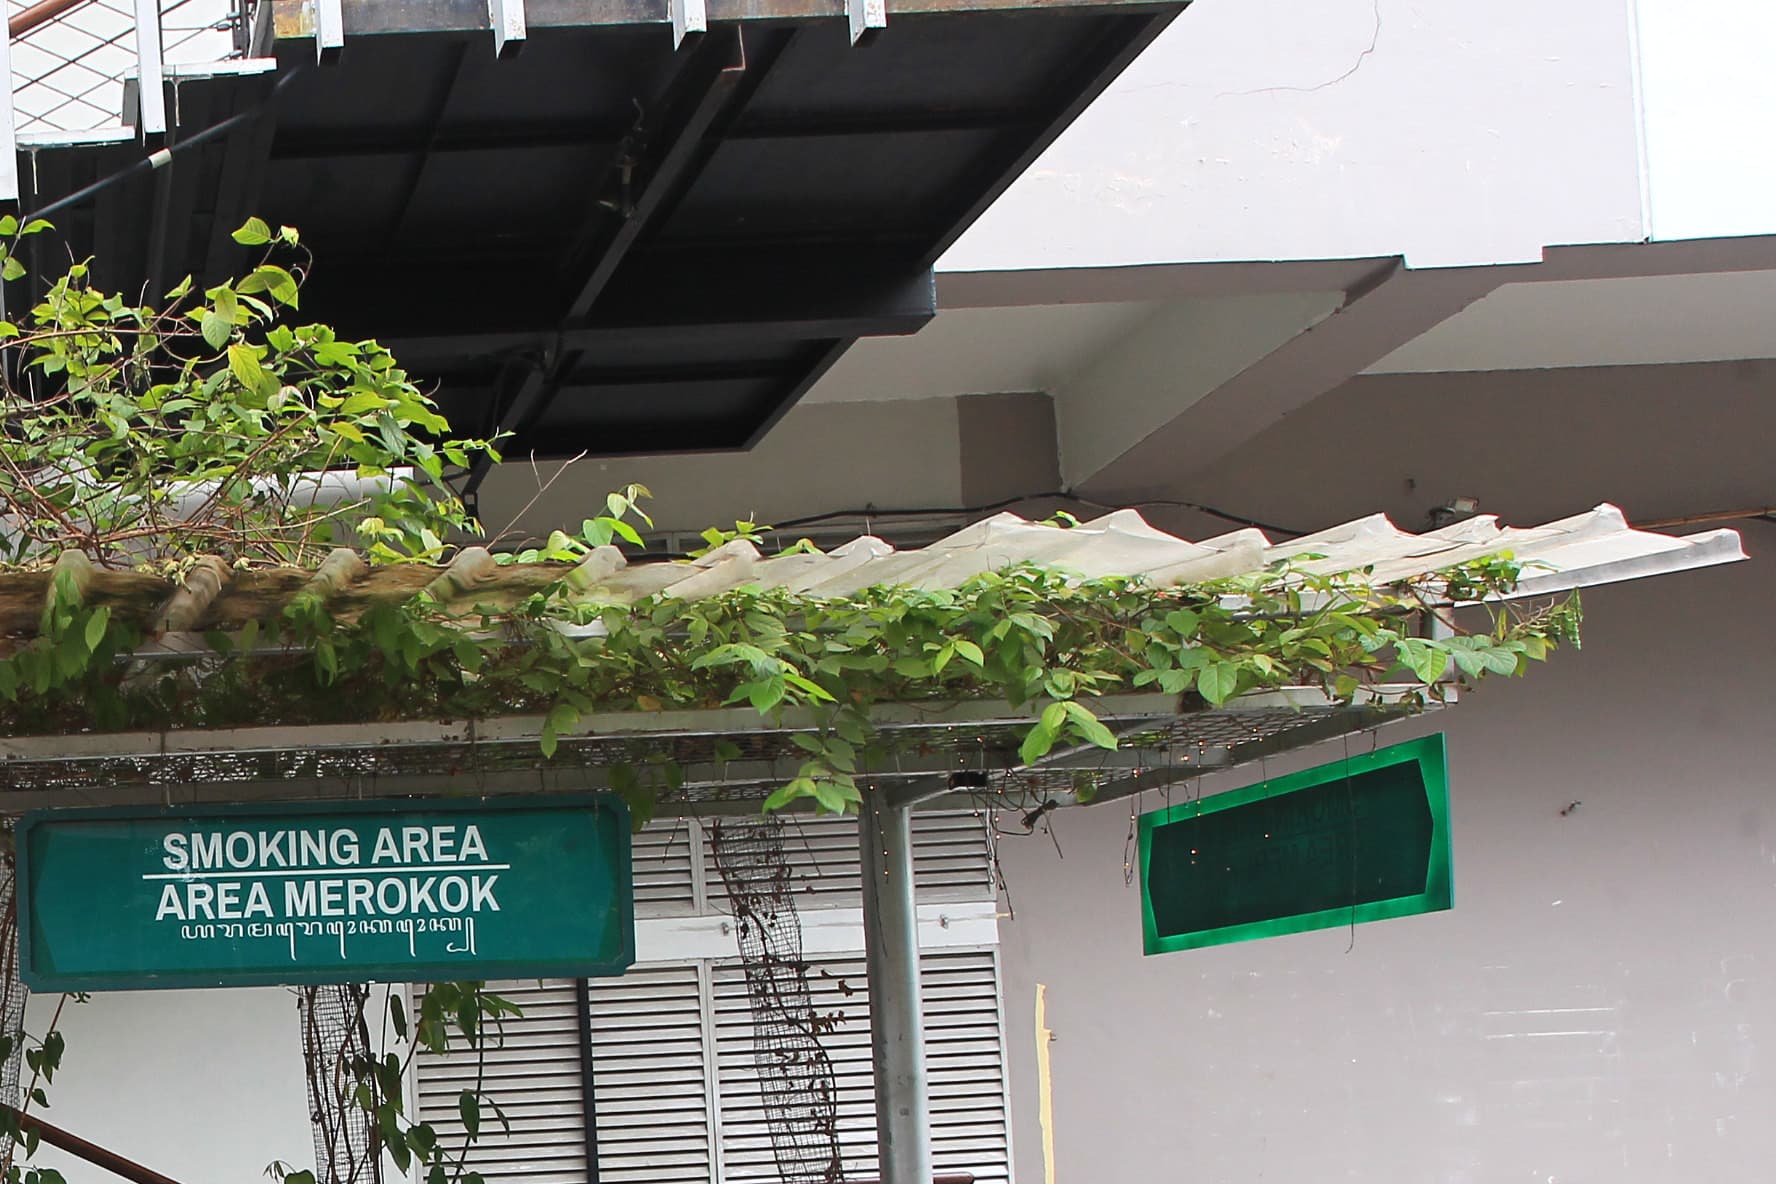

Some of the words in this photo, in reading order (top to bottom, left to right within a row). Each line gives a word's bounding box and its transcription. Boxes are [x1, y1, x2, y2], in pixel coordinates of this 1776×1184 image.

[162, 829, 360, 871] SMOKING
[370, 824, 489, 865] AREA
[155, 881, 274, 922] AREA
[284, 875, 501, 918] MEROKOK
